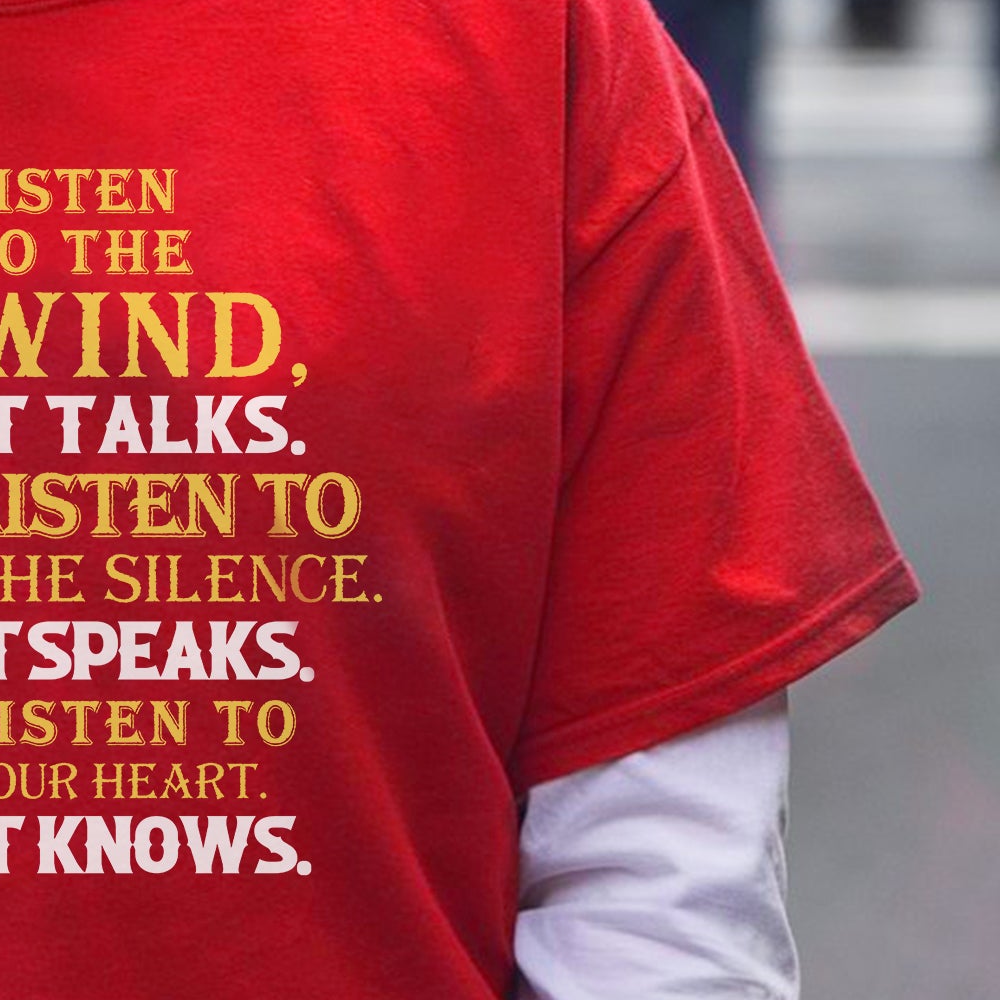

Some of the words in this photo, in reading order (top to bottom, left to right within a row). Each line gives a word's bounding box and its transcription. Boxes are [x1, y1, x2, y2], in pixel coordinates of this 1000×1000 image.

[61, 230, 193, 275] THE
[45, 395, 305, 455] TALKS.
[254, 472, 361, 539] TO
[104, 554, 382, 603] SILENCE.
[28, 621, 314, 682] SPEAKS.
[213, 700, 296, 746] TO
[92, 763, 266, 799] HEART.
[37, 816, 311, 875] KNOWS.
